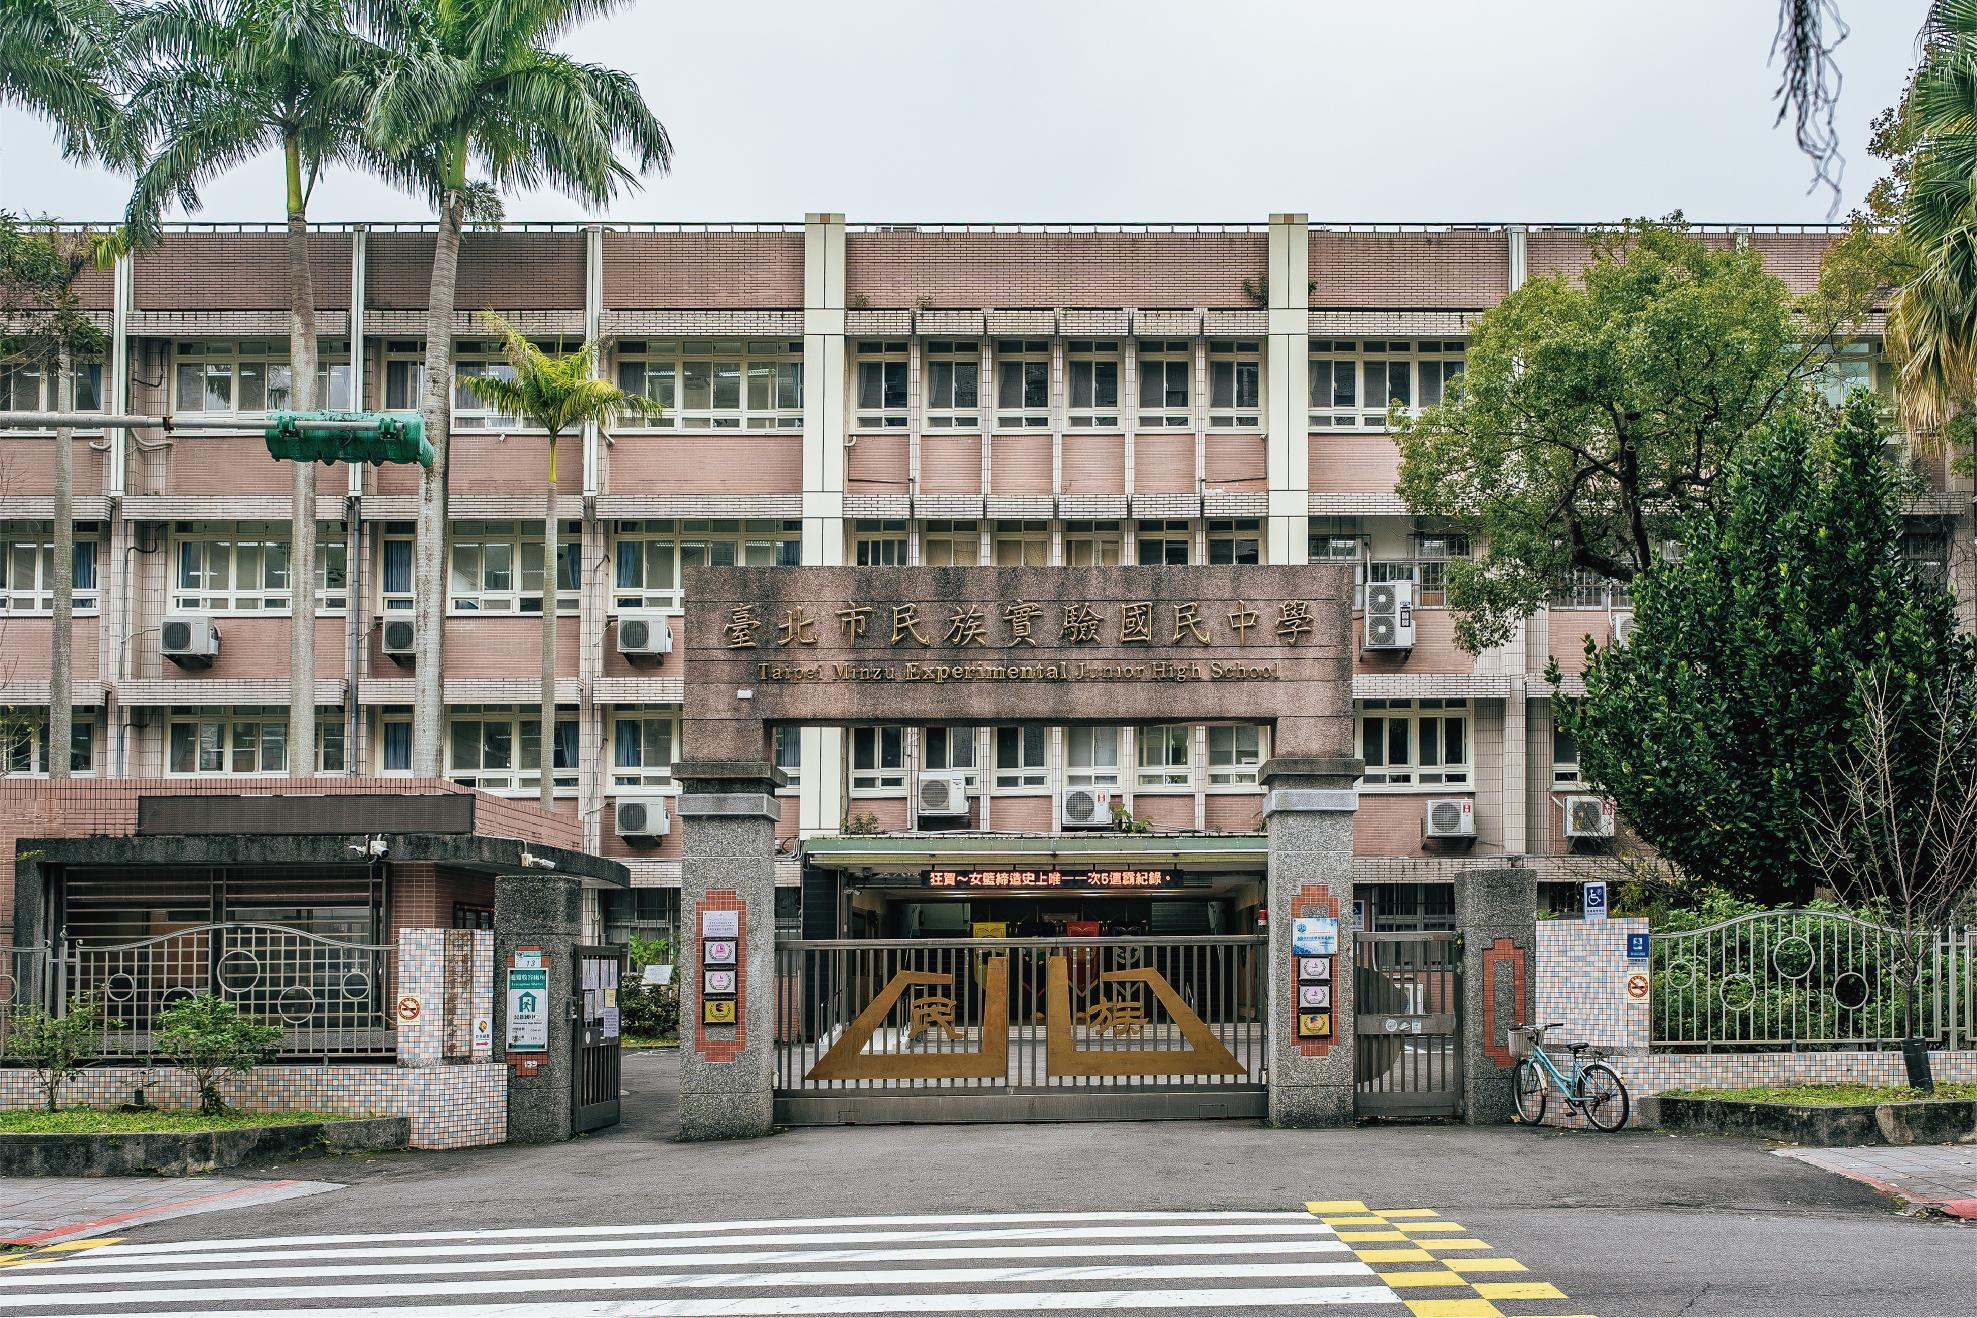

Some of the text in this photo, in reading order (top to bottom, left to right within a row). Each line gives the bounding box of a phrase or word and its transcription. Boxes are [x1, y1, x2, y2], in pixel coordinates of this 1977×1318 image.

[721, 599, 1315, 649] 臺北市民族實驗國民中學
[758, 661, 1282, 683] Taipei Minzu Experimental Junior High School
[908, 995, 1149, 1040] 民 族
